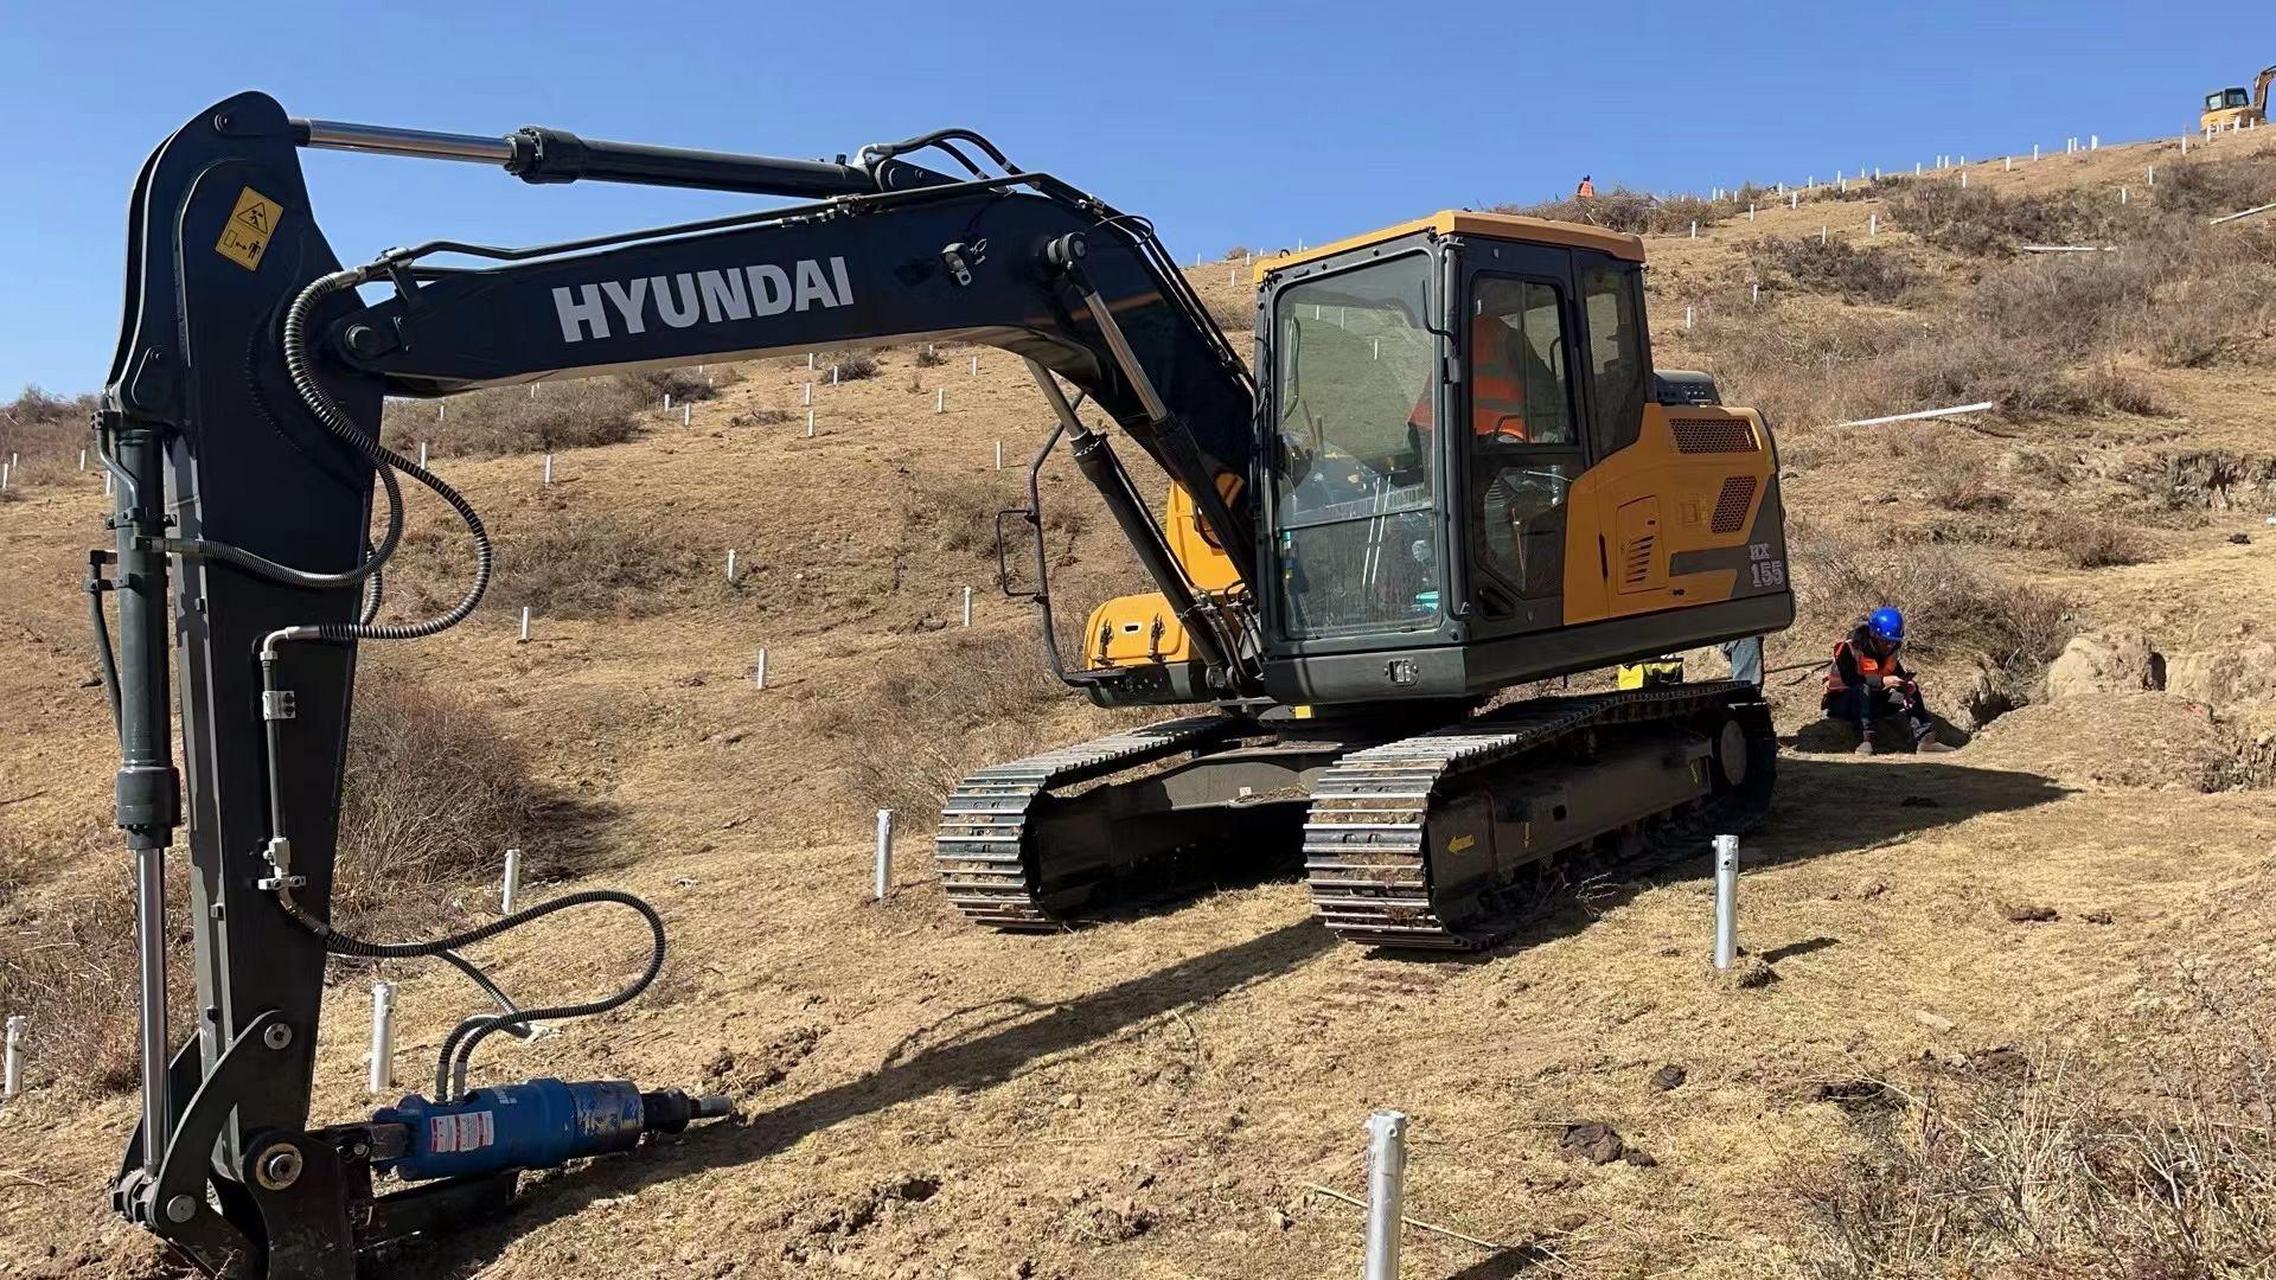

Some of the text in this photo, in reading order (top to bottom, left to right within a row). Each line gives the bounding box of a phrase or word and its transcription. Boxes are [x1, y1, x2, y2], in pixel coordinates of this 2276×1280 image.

[552, 256, 854, 343] HYUNDAI
[1750, 543, 1770, 560] HX
[1751, 560, 1784, 588] 155
